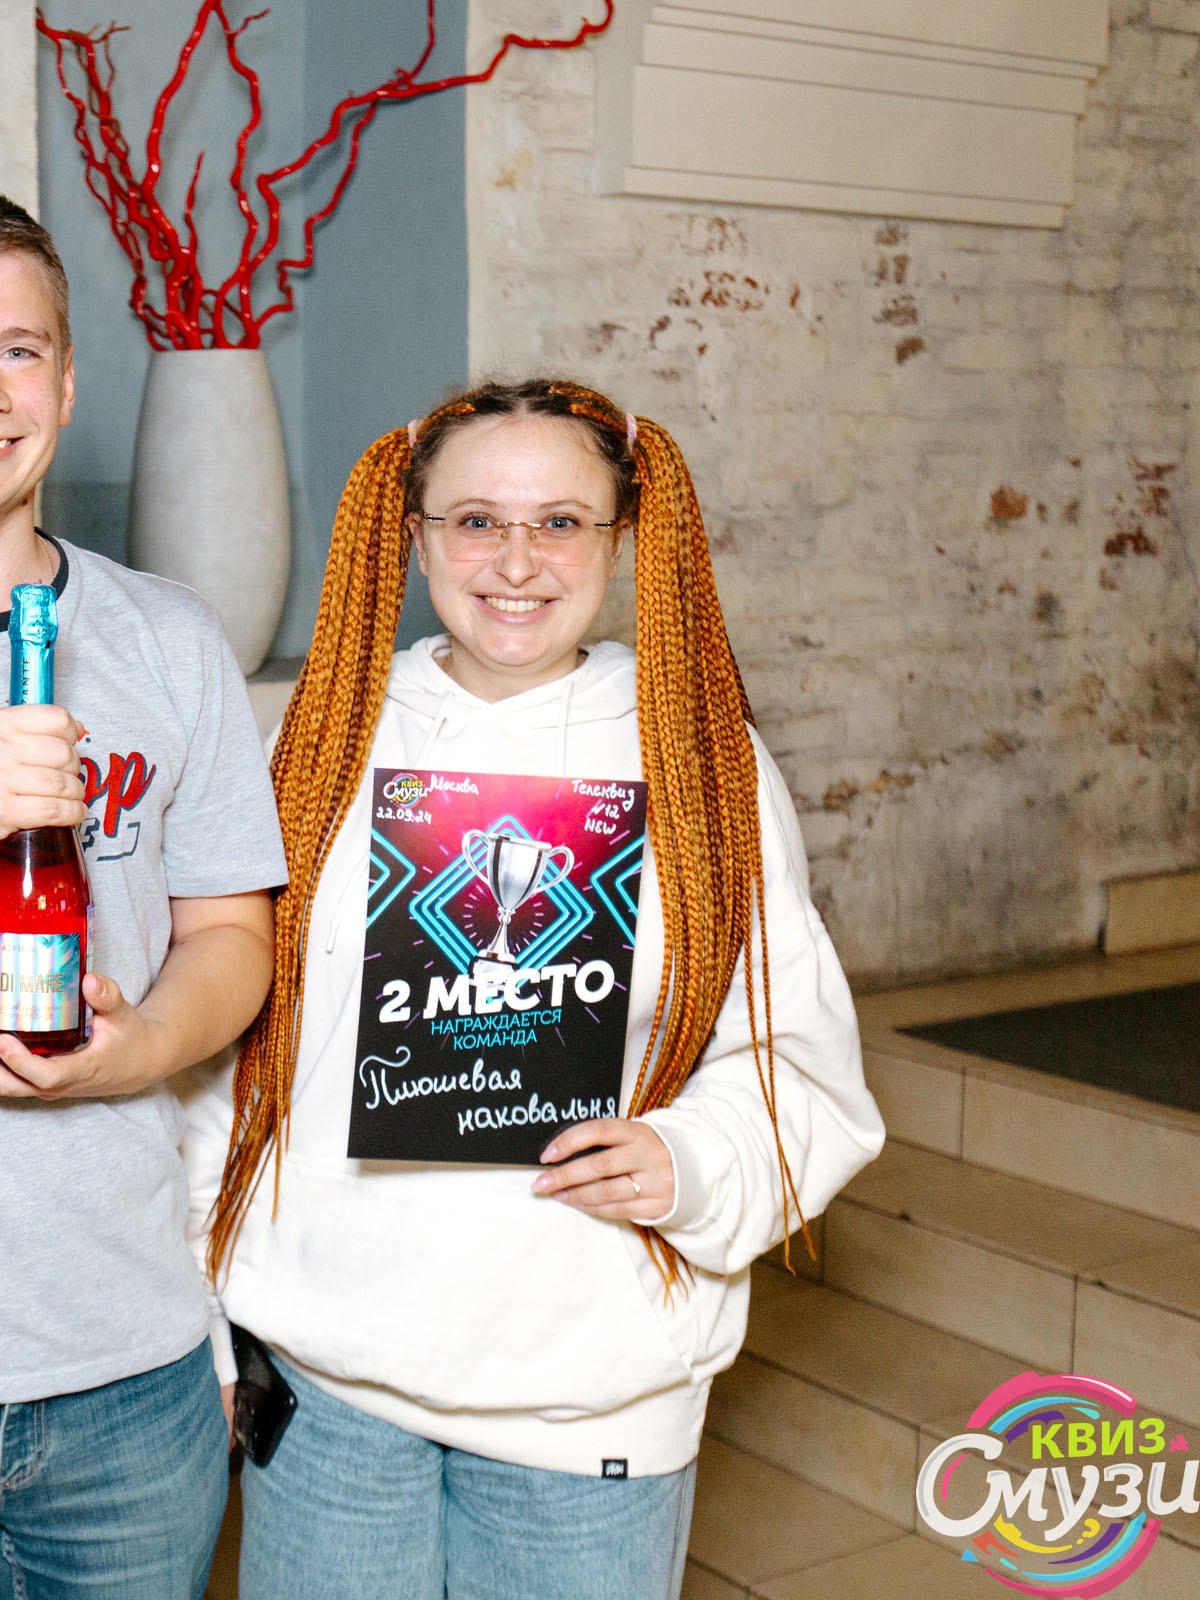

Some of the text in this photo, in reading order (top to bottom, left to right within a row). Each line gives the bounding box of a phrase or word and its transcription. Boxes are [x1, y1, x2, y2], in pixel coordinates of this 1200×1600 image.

[383, 781, 429, 800] Смузи
[401, 780, 423, 788] КВИЗ
[376, 806, 432, 825] 22.09.24
[0, 972, 14, 992] DI
[19, 972, 65, 994] MARE
[379, 959, 615, 1023] 2 МЕСТО
[431, 1008, 562, 1036] НАГРАЖДАЕТСЯ
[453, 1029, 538, 1051] КОМАНДА
